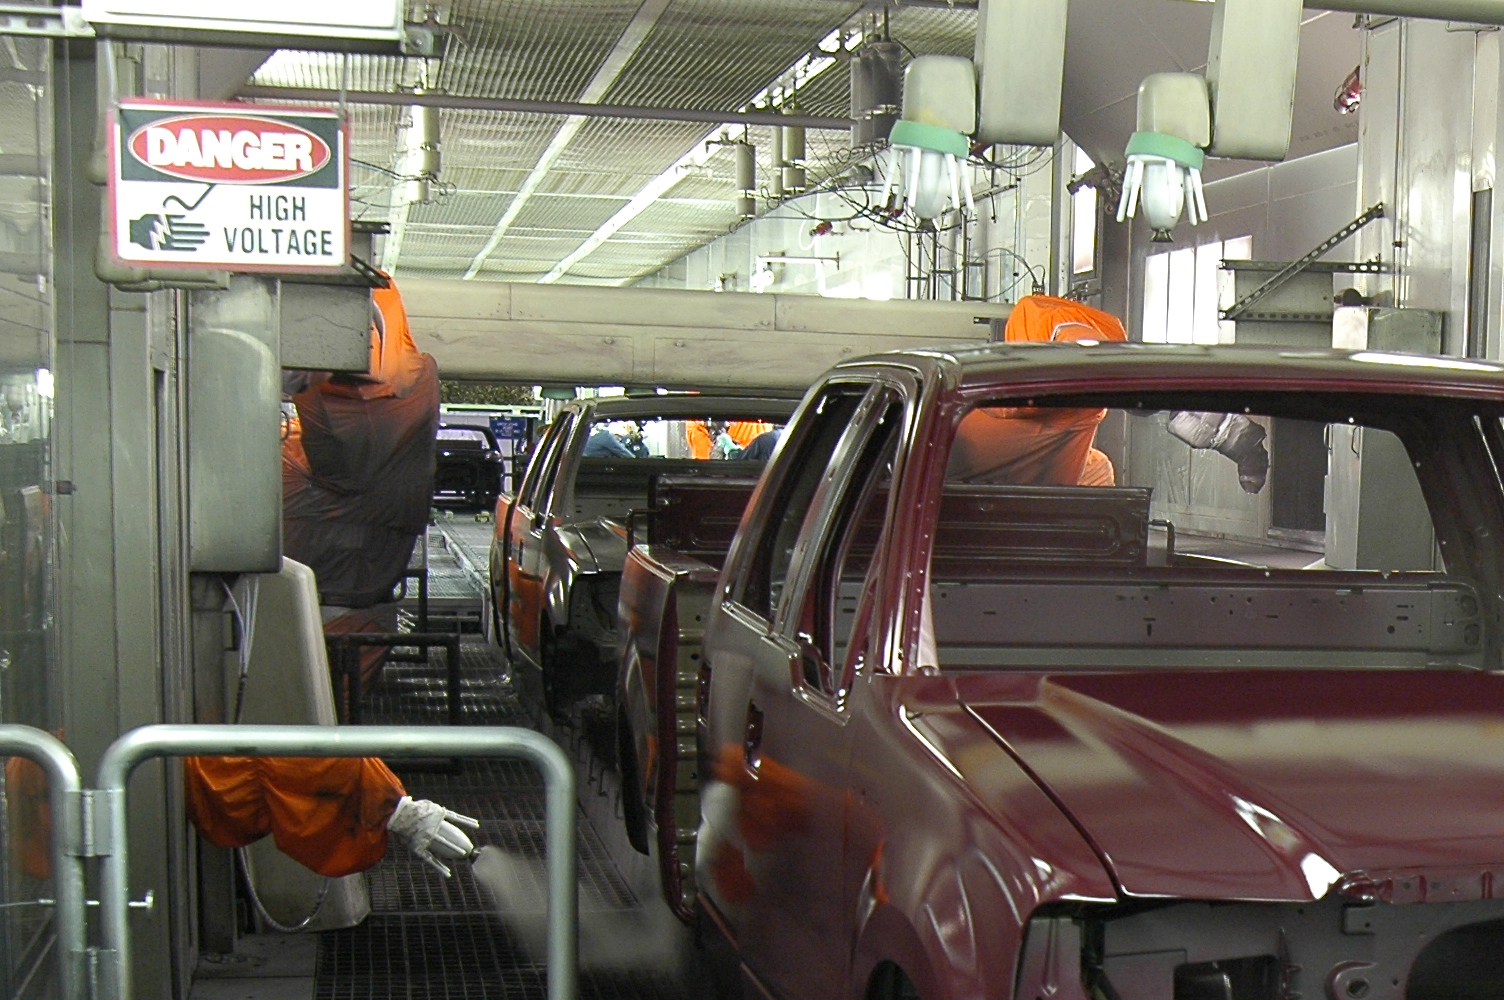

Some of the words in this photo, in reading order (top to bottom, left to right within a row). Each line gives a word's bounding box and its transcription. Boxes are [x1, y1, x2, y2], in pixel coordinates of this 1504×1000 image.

[147, 128, 313, 172] DANGER
[249, 195, 306, 221] HIGH
[223, 227, 333, 256] VOLTAGE
